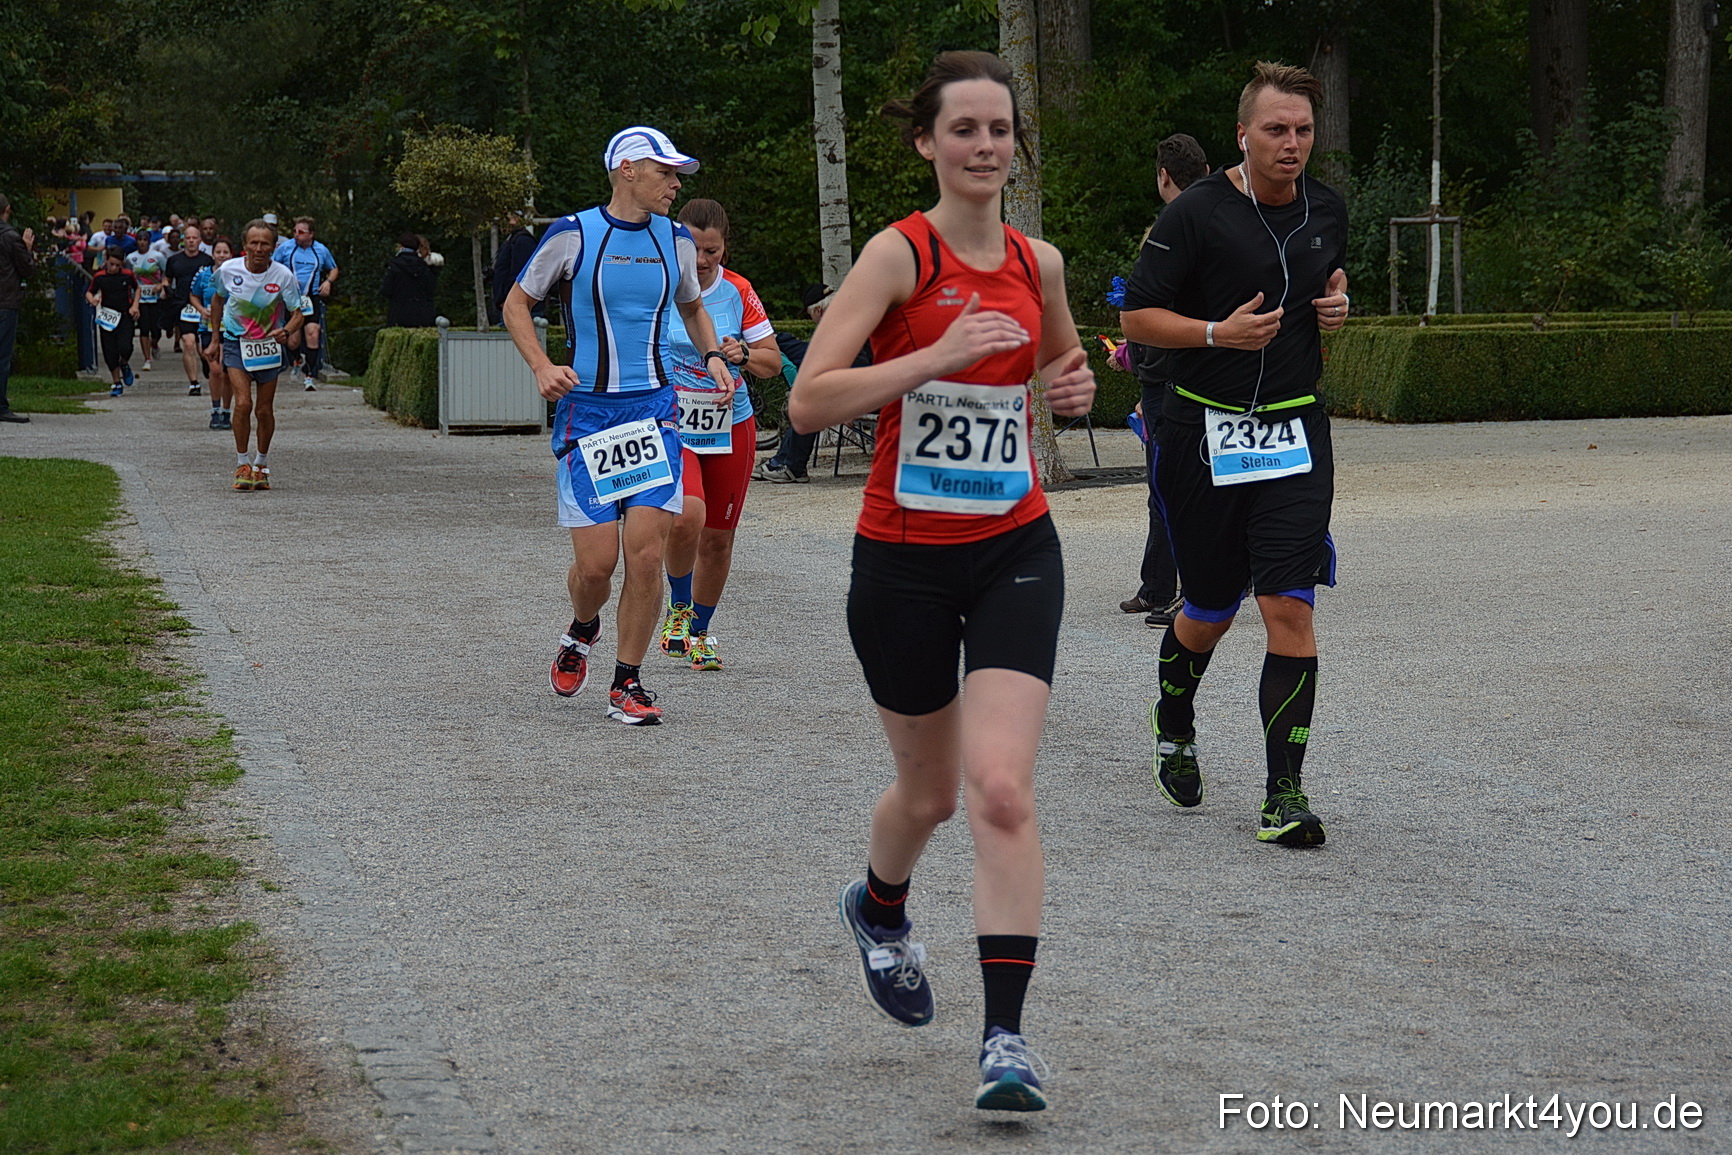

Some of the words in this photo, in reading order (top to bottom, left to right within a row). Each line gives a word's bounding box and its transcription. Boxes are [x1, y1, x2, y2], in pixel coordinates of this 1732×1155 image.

[98, 311, 118, 324] 2520
[245, 341, 278, 358] 3053
[907, 391, 954, 408] PARTL
[956, 397, 1010, 411] Neumarkt
[678, 406, 728, 431] 2457
[581, 436, 609, 451] PARTL
[609, 426, 646, 442] Neumarkt
[915, 412, 1019, 464] 2376
[1217, 420, 1297, 450] 2324
[593, 434, 659, 476] 2495
[1240, 455, 1282, 470] Stefan
[611, 468, 652, 490] Michael
[929, 471, 1006, 497] Veronika
